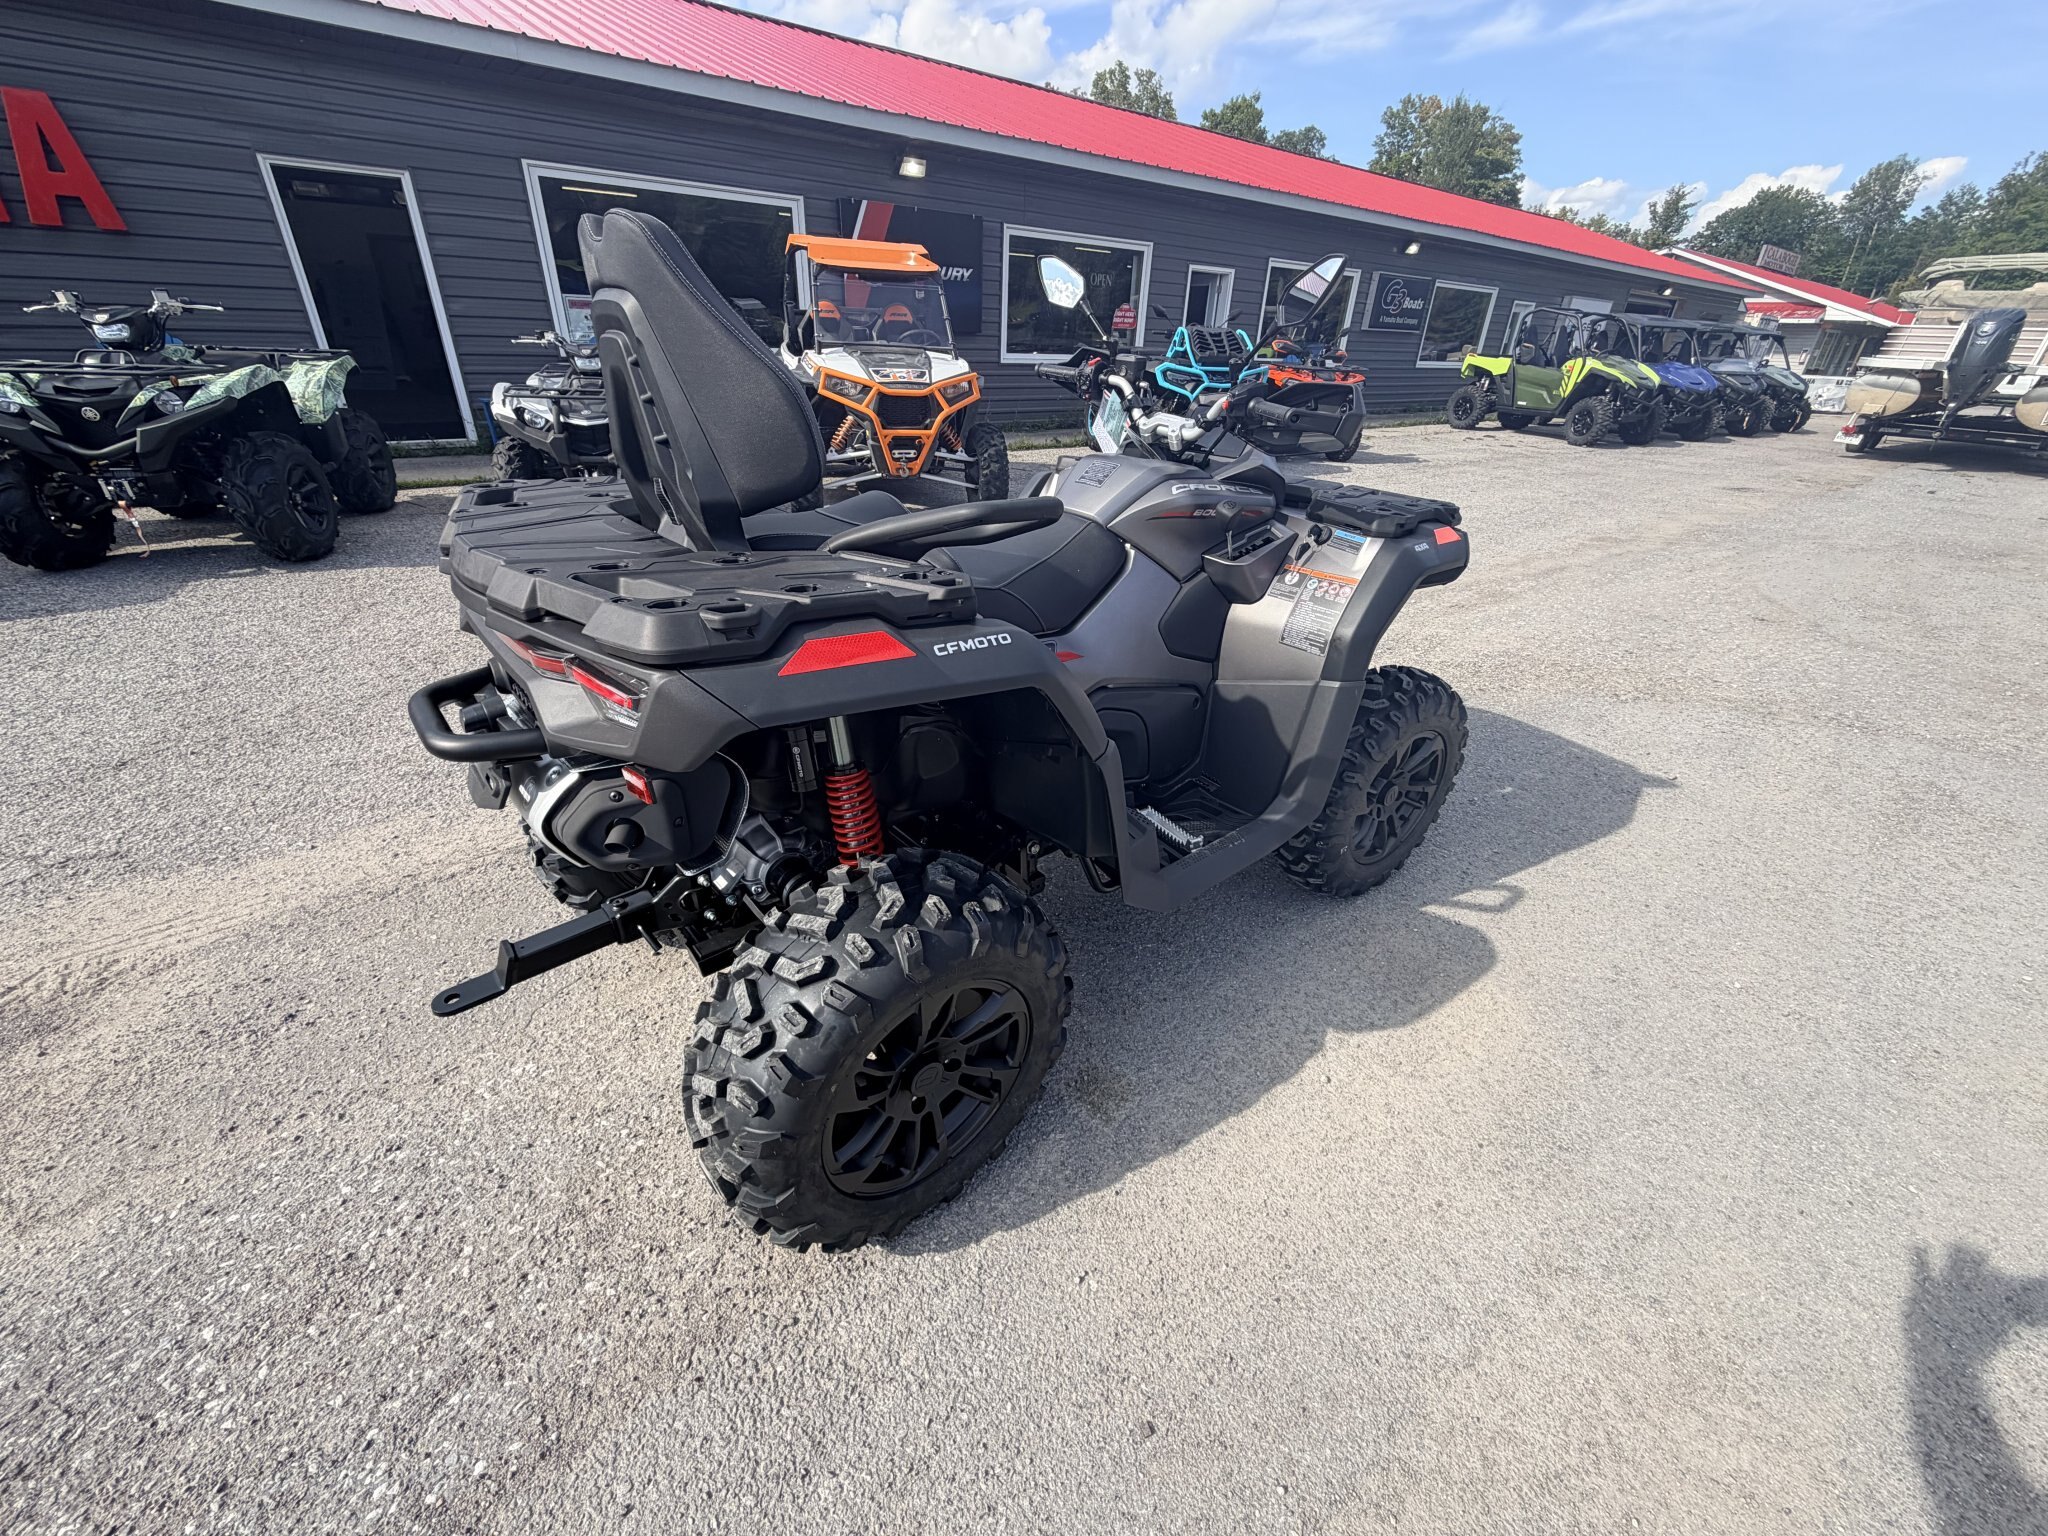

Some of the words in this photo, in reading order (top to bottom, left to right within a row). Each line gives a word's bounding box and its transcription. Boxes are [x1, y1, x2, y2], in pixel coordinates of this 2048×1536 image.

[0, 86, 128, 231] A
[938, 267, 973, 281] URY
[1403, 297, 1424, 309] Boats
[933, 633, 1012, 656] CFMOTO
